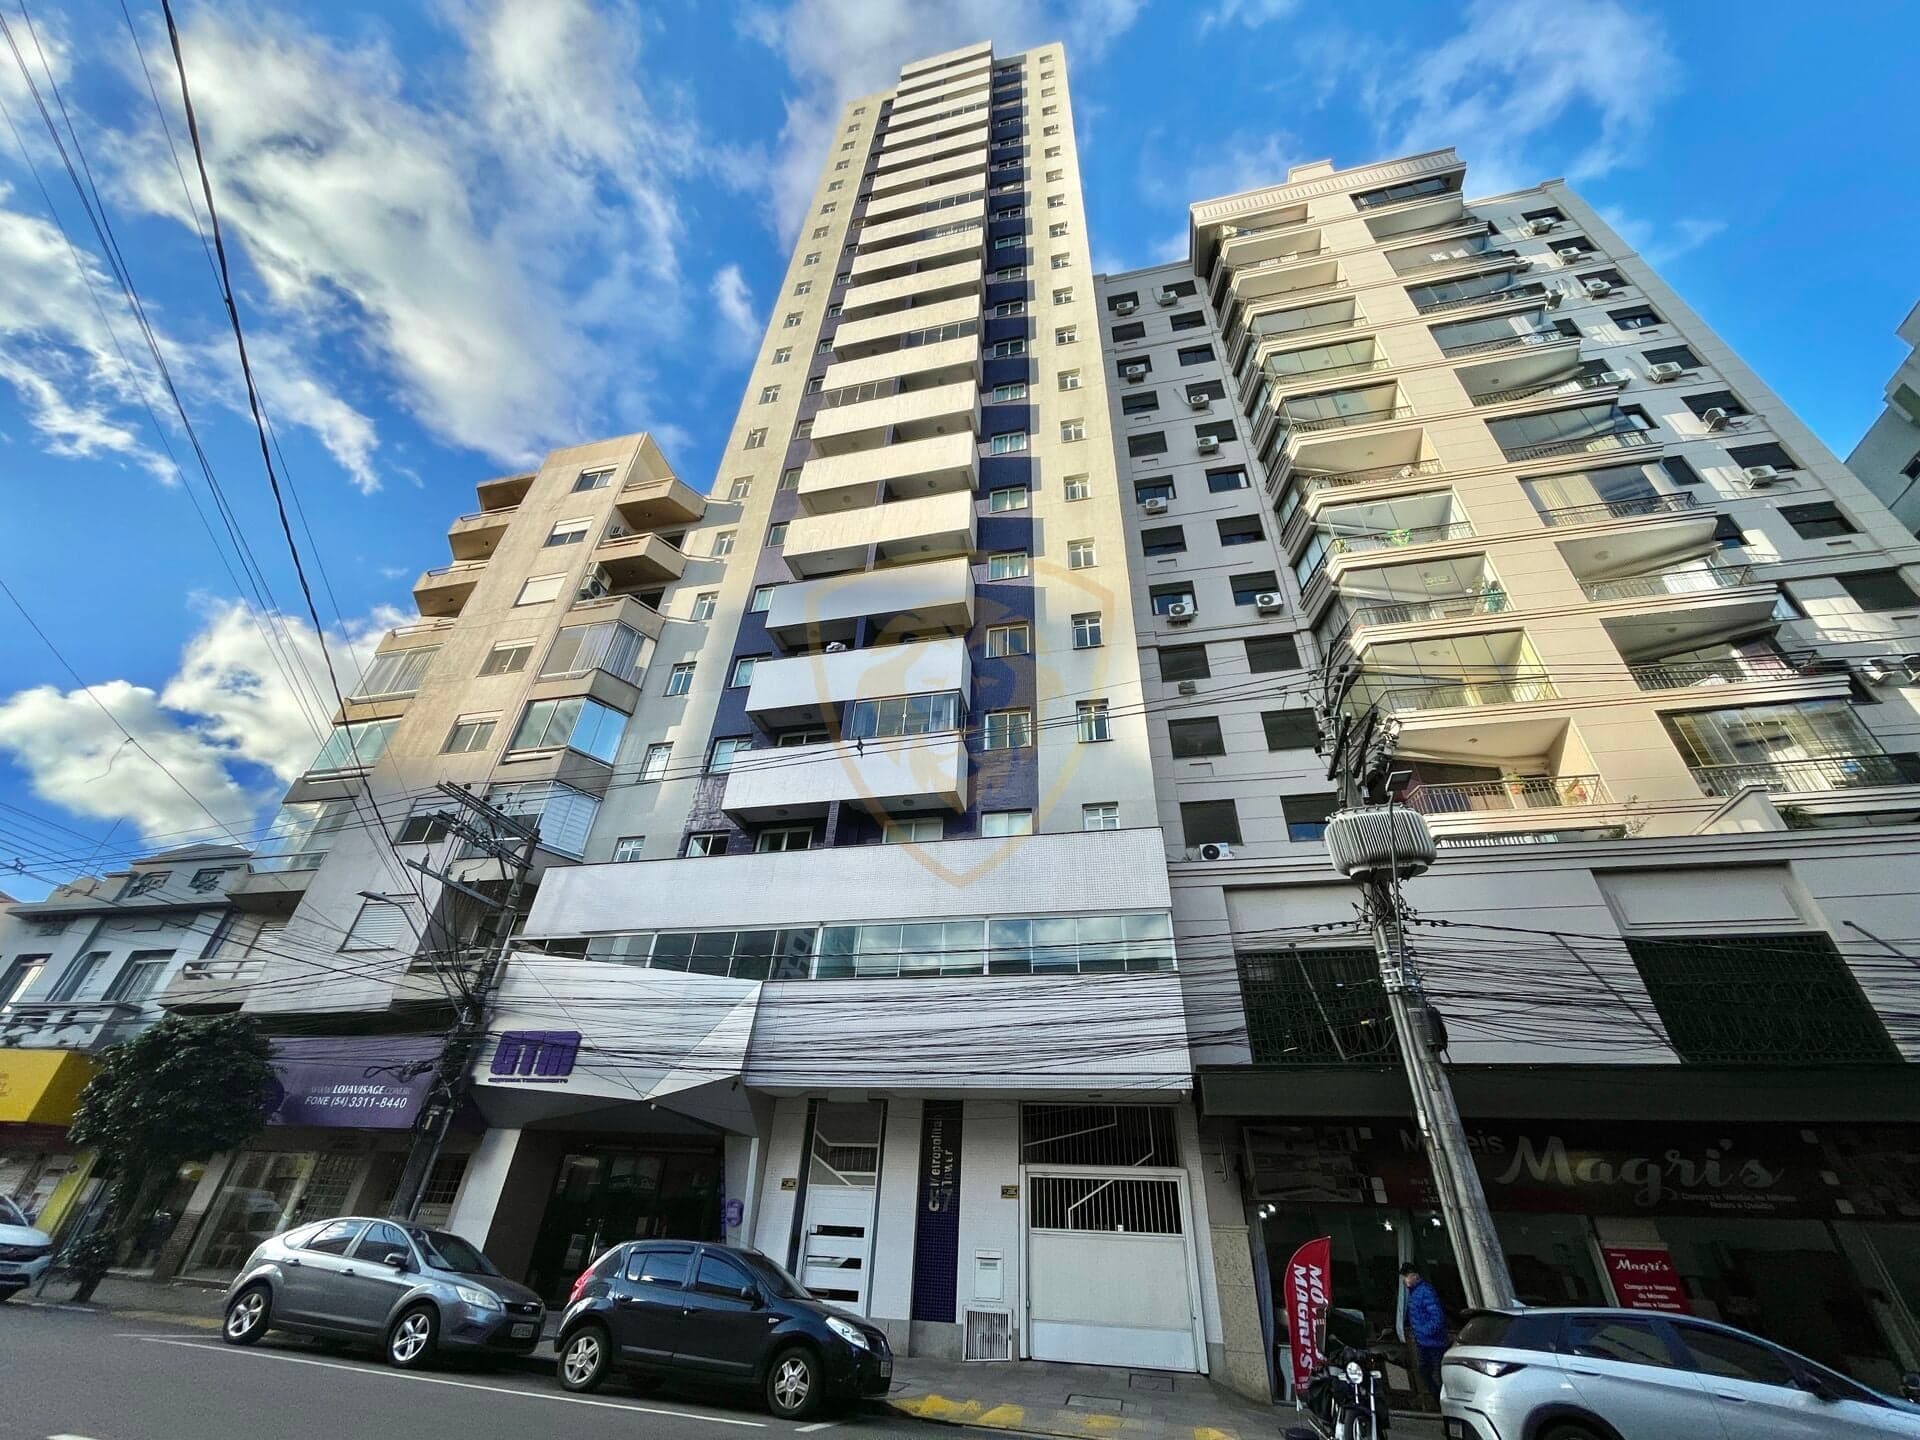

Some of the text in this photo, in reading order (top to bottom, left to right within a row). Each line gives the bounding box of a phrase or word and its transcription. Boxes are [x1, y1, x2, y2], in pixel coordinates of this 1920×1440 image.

[304, 1095, 408, 1109] FONE (54) 3311-8440
[1616, 1259, 1670, 1273] Magri's
[1293, 1263, 1314, 1369] MAGRI'S
